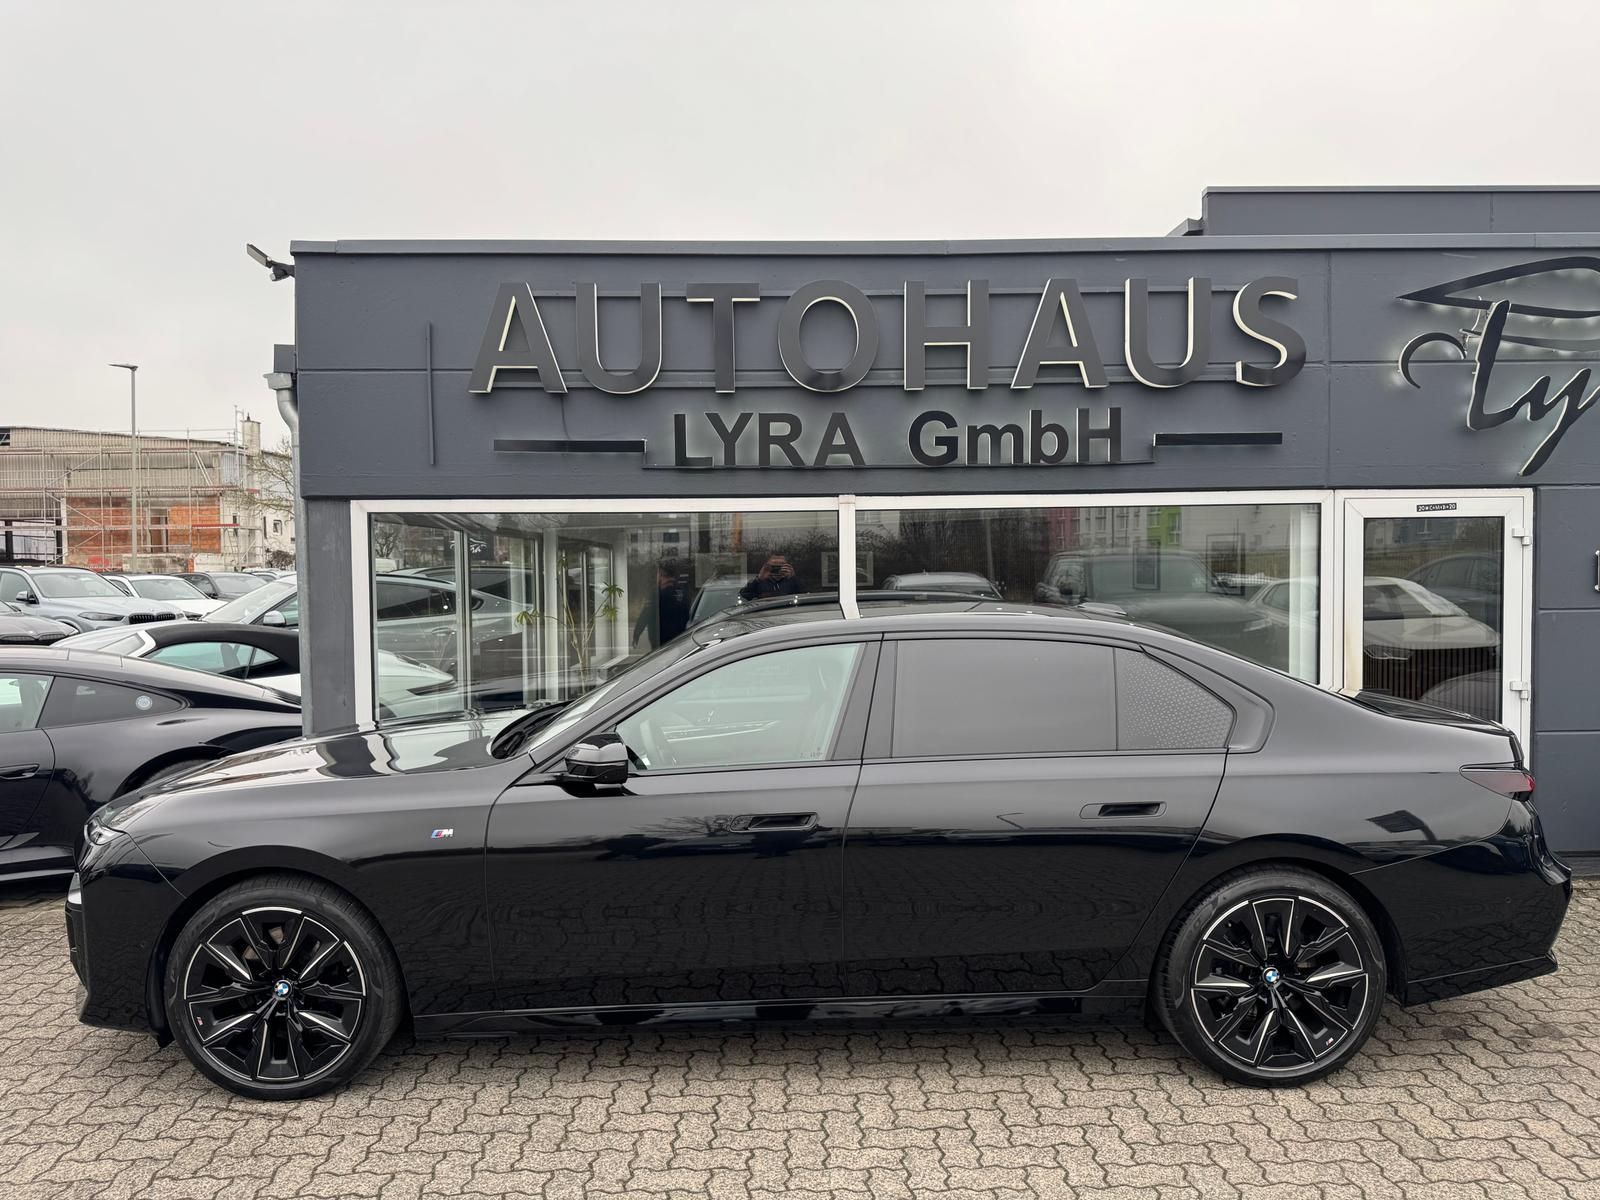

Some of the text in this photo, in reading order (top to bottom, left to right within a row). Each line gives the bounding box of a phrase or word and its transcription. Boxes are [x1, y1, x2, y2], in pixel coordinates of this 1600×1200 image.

[468, 276, 1307, 394] AUTOHAUS
[1467, 299, 1600, 477] Ly
[673, 406, 1122, 468] LYRA GmbH
